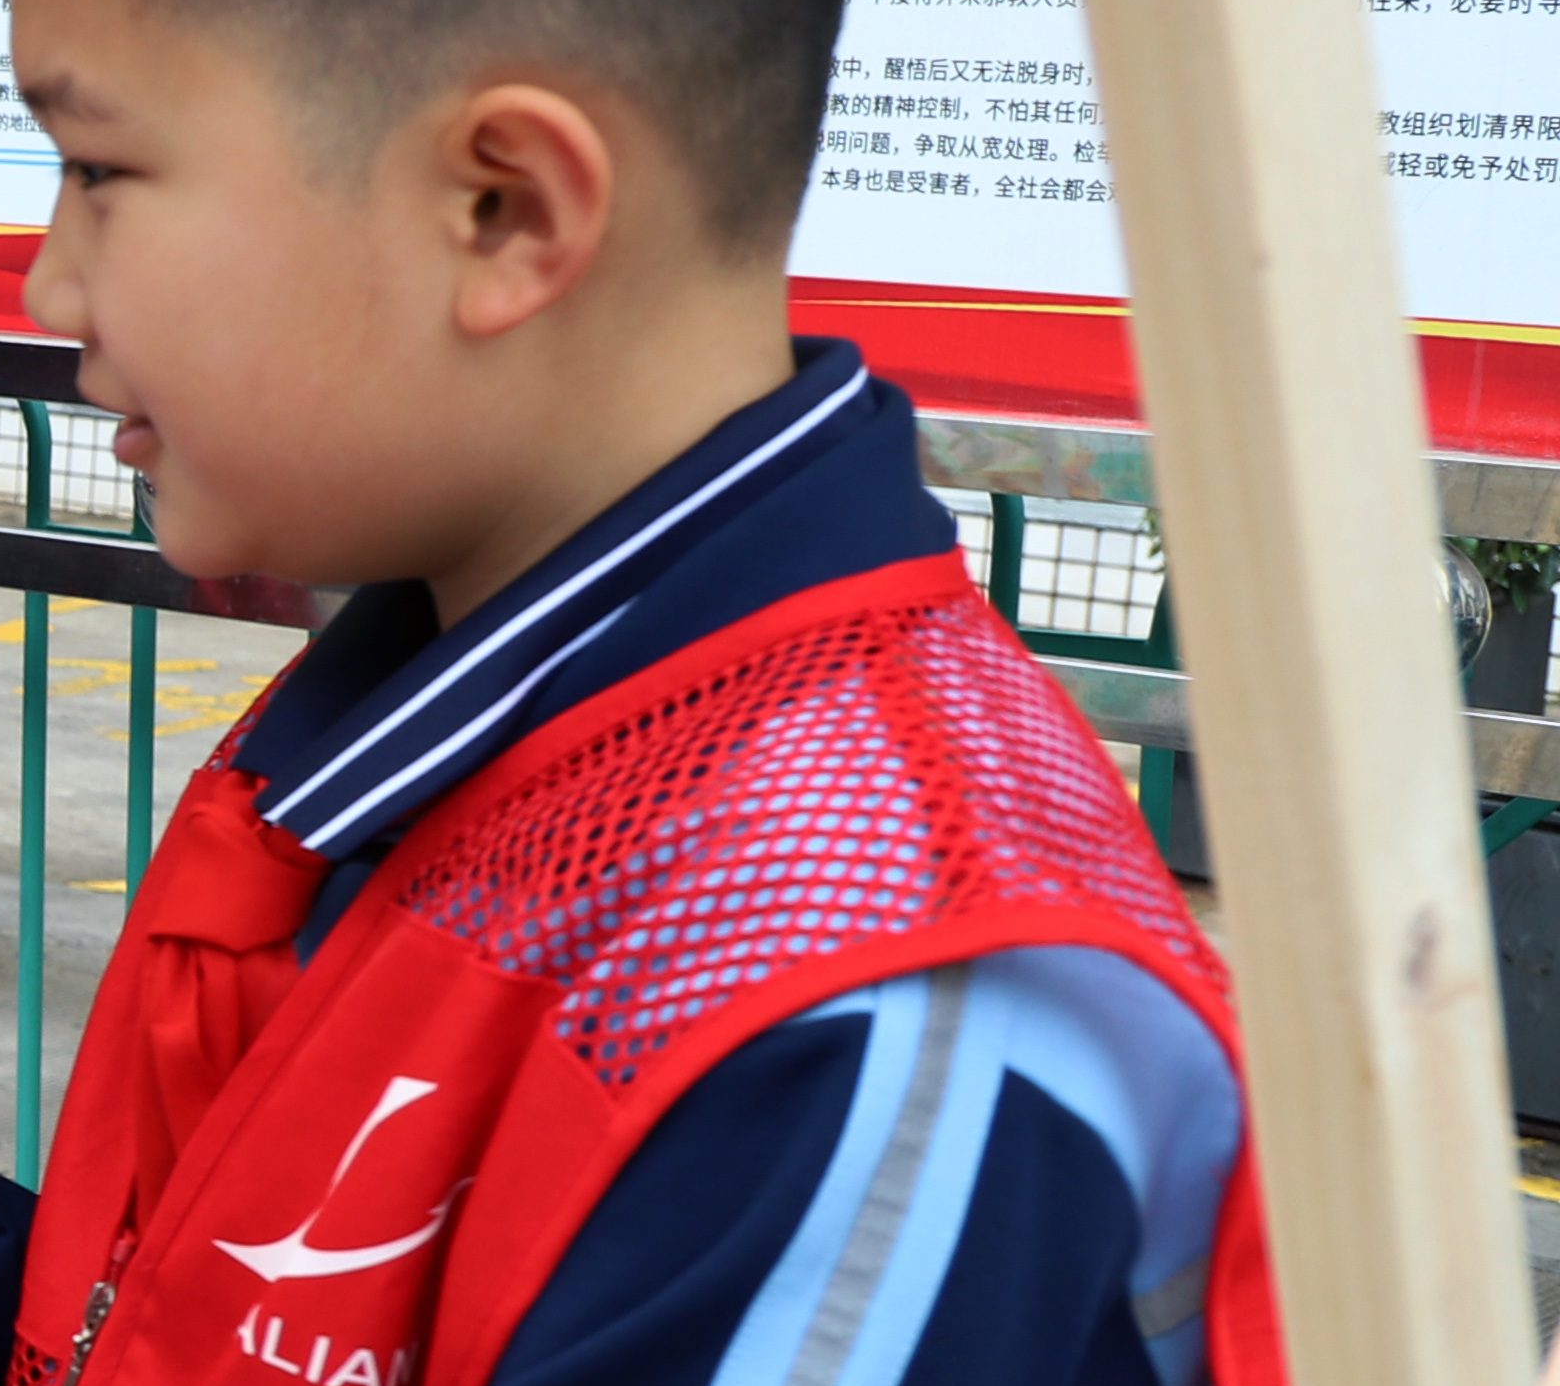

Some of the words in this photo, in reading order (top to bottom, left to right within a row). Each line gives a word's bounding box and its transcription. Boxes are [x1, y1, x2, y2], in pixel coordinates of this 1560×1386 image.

[822, 93, 1105, 125] 教的精神控制，不怕其任何
